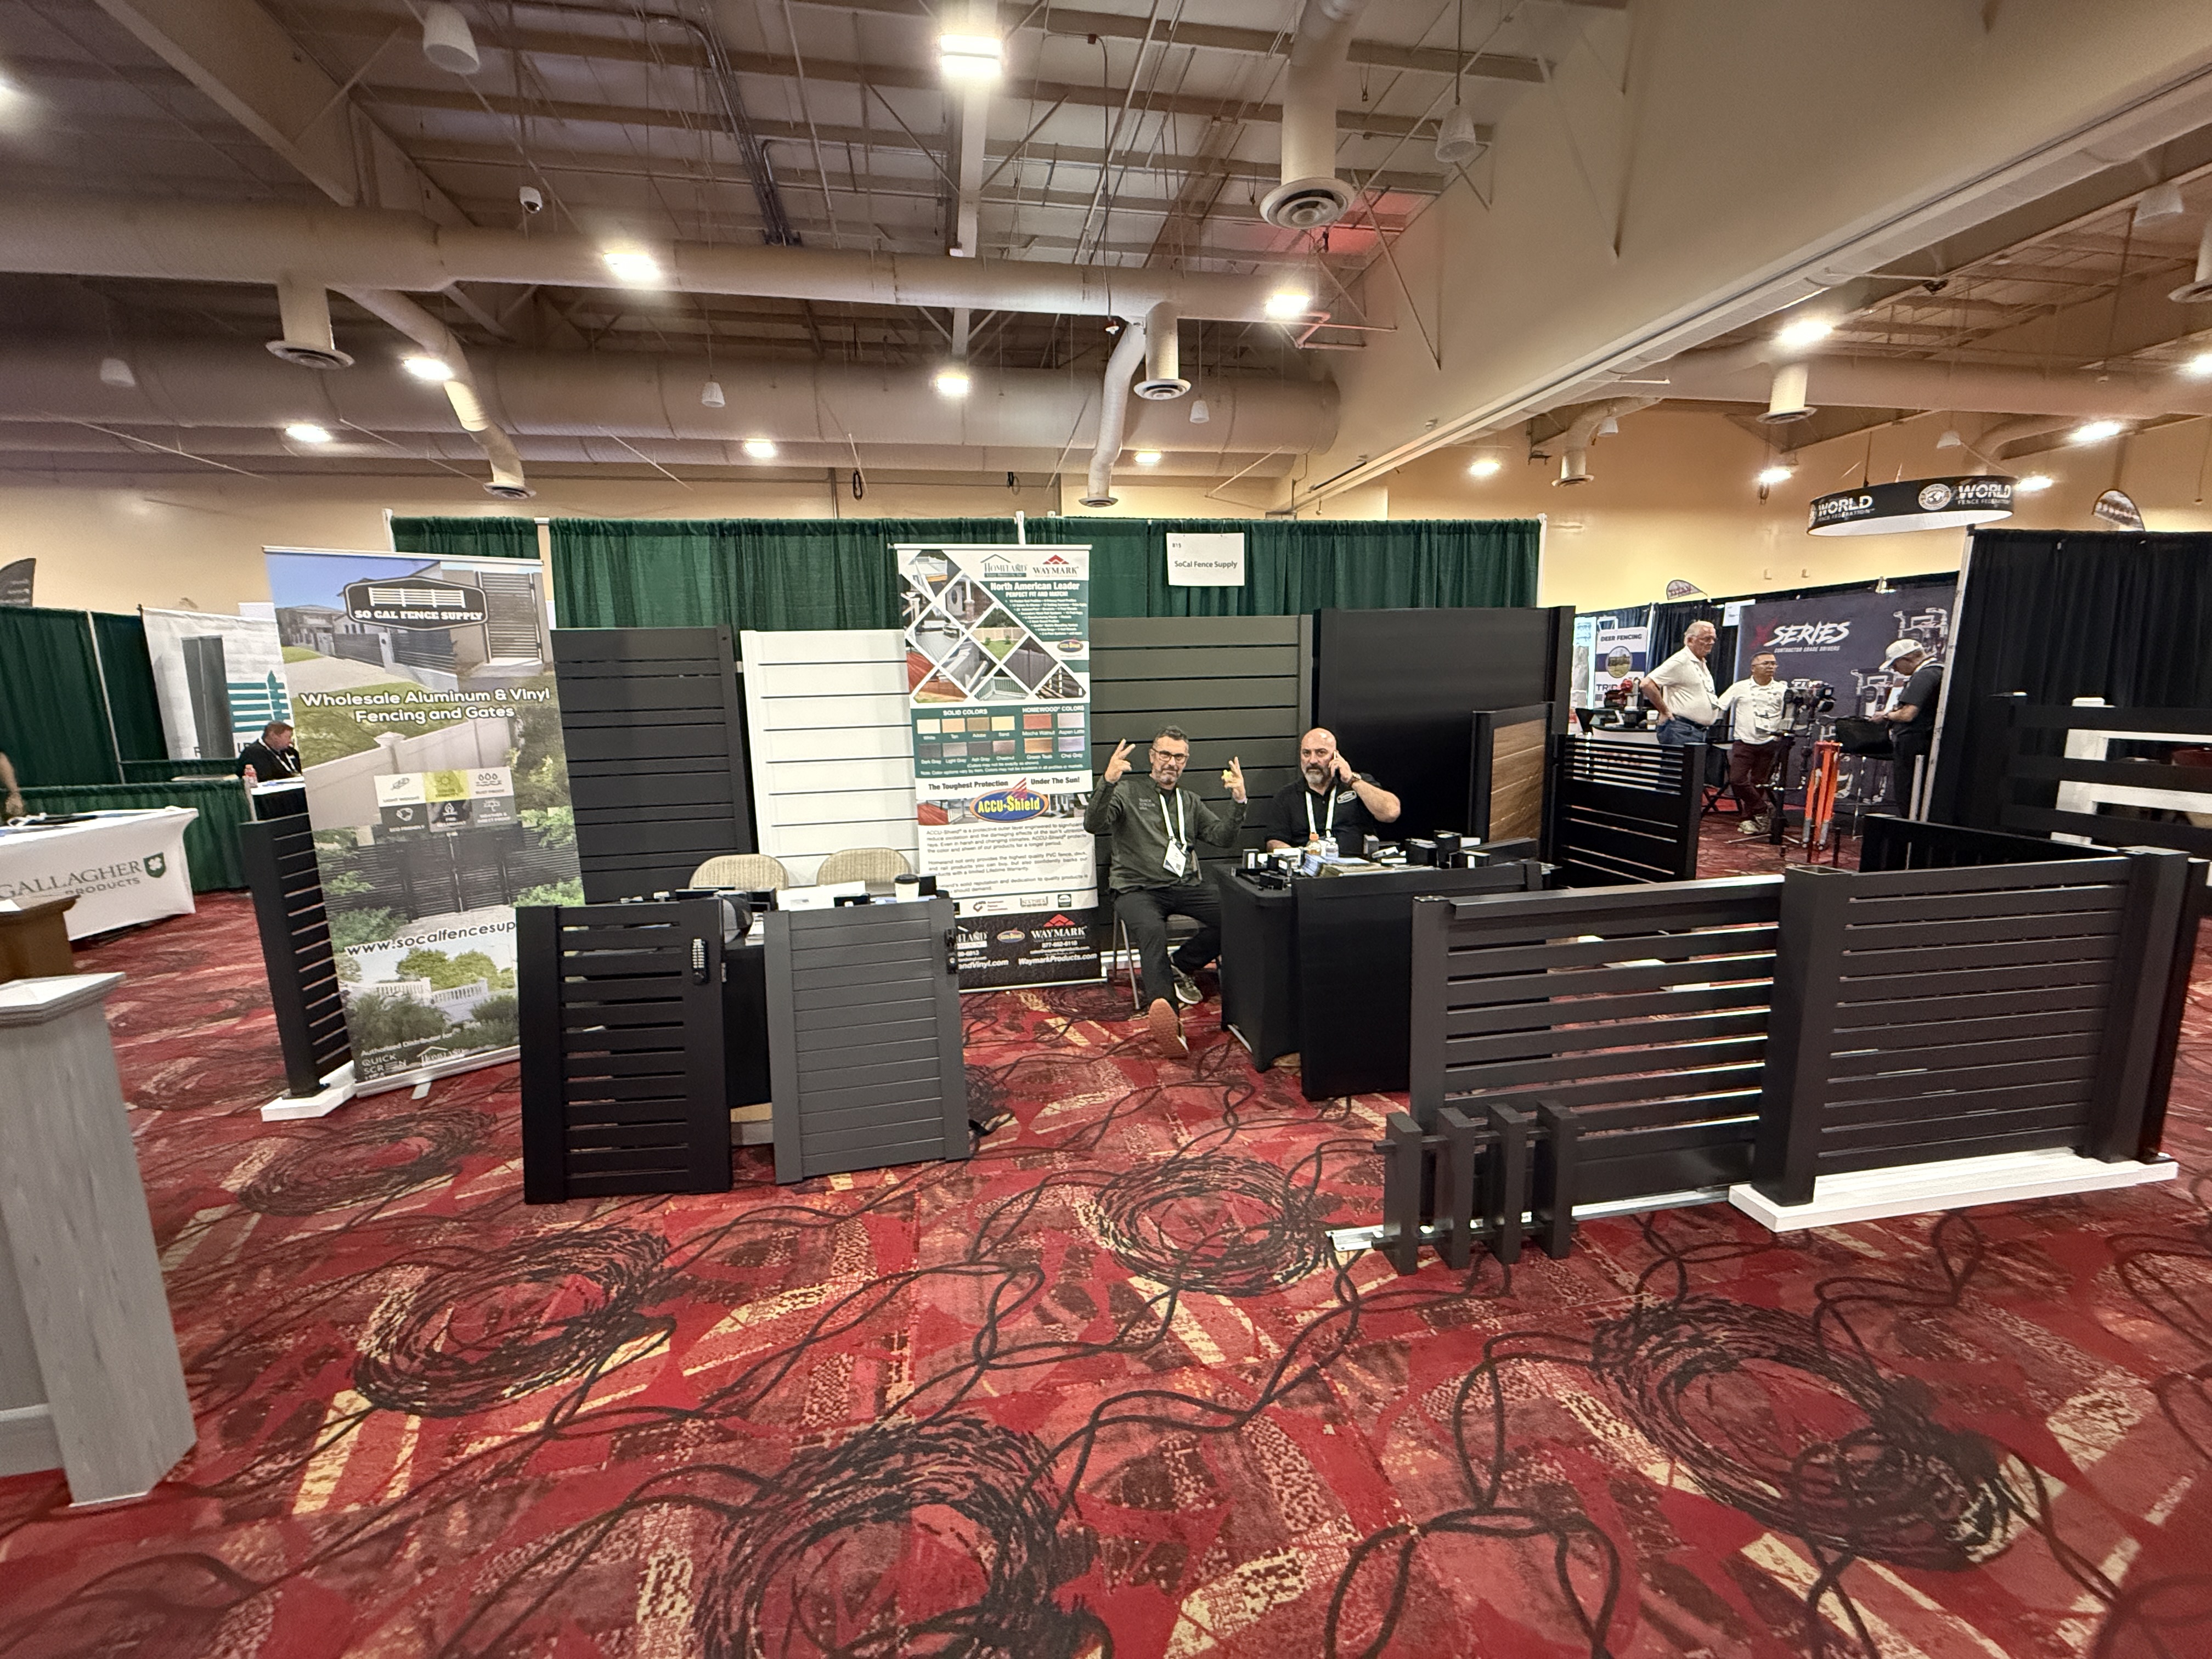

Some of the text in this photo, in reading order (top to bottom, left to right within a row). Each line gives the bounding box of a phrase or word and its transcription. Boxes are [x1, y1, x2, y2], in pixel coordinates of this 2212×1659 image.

[1959, 484, 2012, 499] WORLD
[1819, 495, 1873, 517] WORLD
[1032, 566, 1079, 574] WAYMARK
[1214, 560, 1238, 569] Supply
[990, 582, 1080, 590] North American Leader
[355, 610, 483, 620] SO CAL FENCE SUPPLY
[1763, 620, 1852, 647] SERIES
[300, 687, 550, 708] Wholesale Aluminum & Vinyl
[356, 706, 515, 725] Fencing and Gates
[942, 781, 972, 791] Toughest
[974, 780, 1008, 788] Protection
[978, 795, 1040, 813] ACCU-Shield
[0, 860, 142, 899] GALLAGHER
[346, 921, 516, 956] www.socalfencesup
[957, 931, 988, 943] ELAND
[1030, 927, 1085, 939] WAYMARK
[958, 959, 1009, 970] andVinyl.com
[1018, 953, 1098, 966] WaymarkProducts.com
[362, 1054, 397, 1067] QUICK
